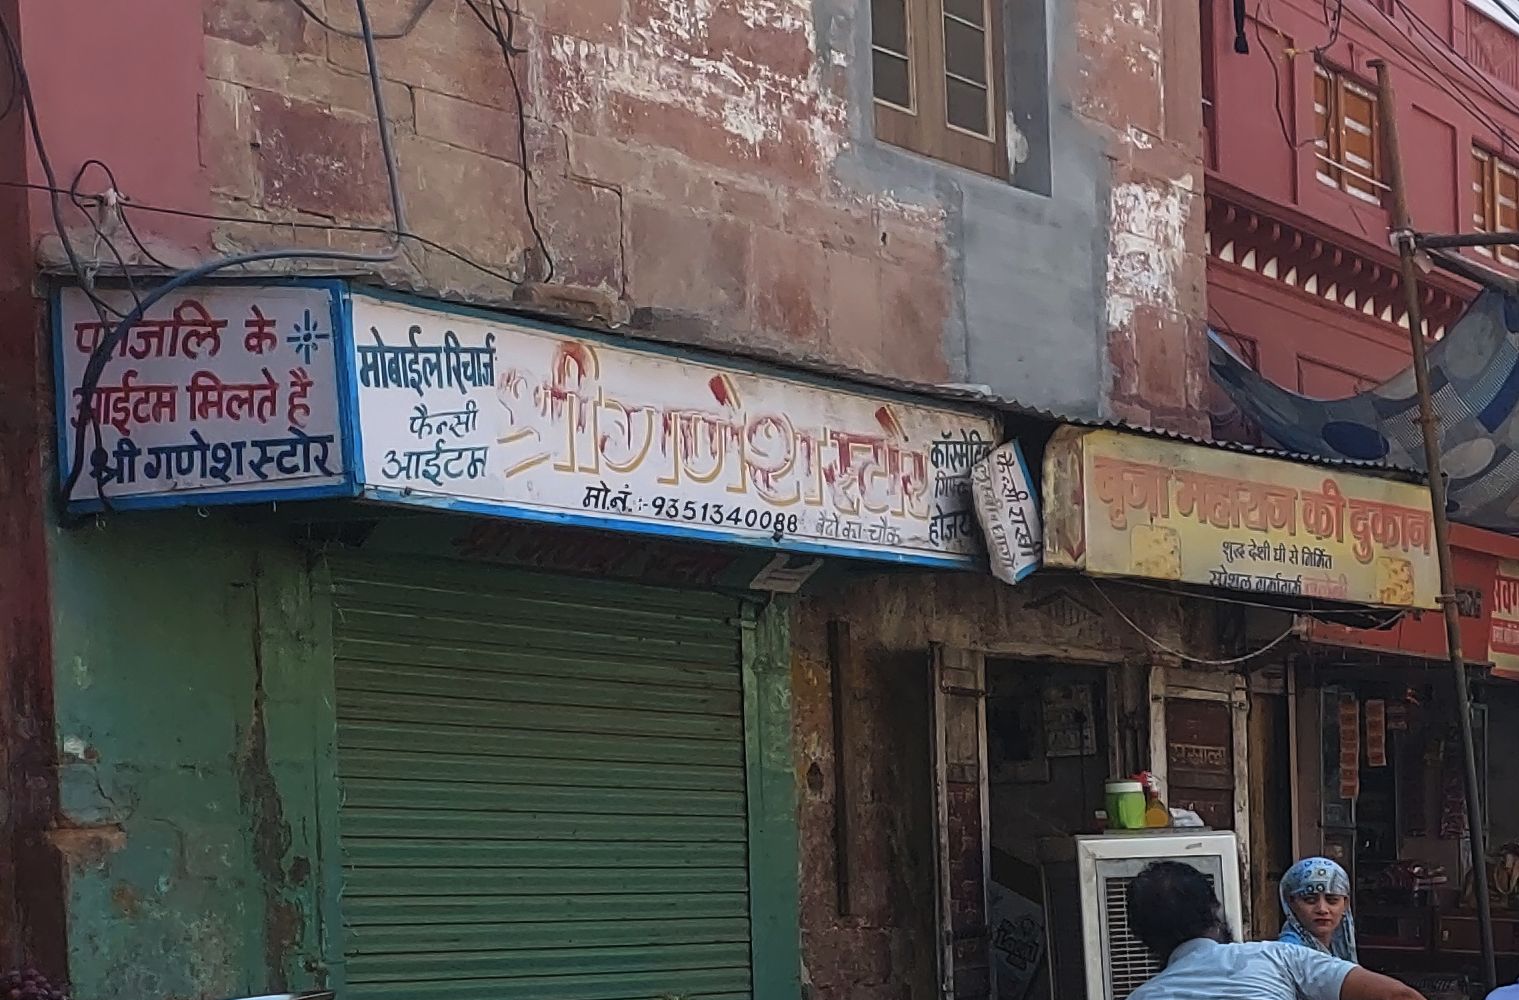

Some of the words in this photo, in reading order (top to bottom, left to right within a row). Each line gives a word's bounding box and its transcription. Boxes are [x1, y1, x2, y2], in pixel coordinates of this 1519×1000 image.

[244, 304, 277, 355] के
[186, 367, 279, 424] मिलते
[382, 439, 490, 486] आईटम
[1301, 478, 1346, 542] की
[1349, 499, 1432, 565] दुकान
